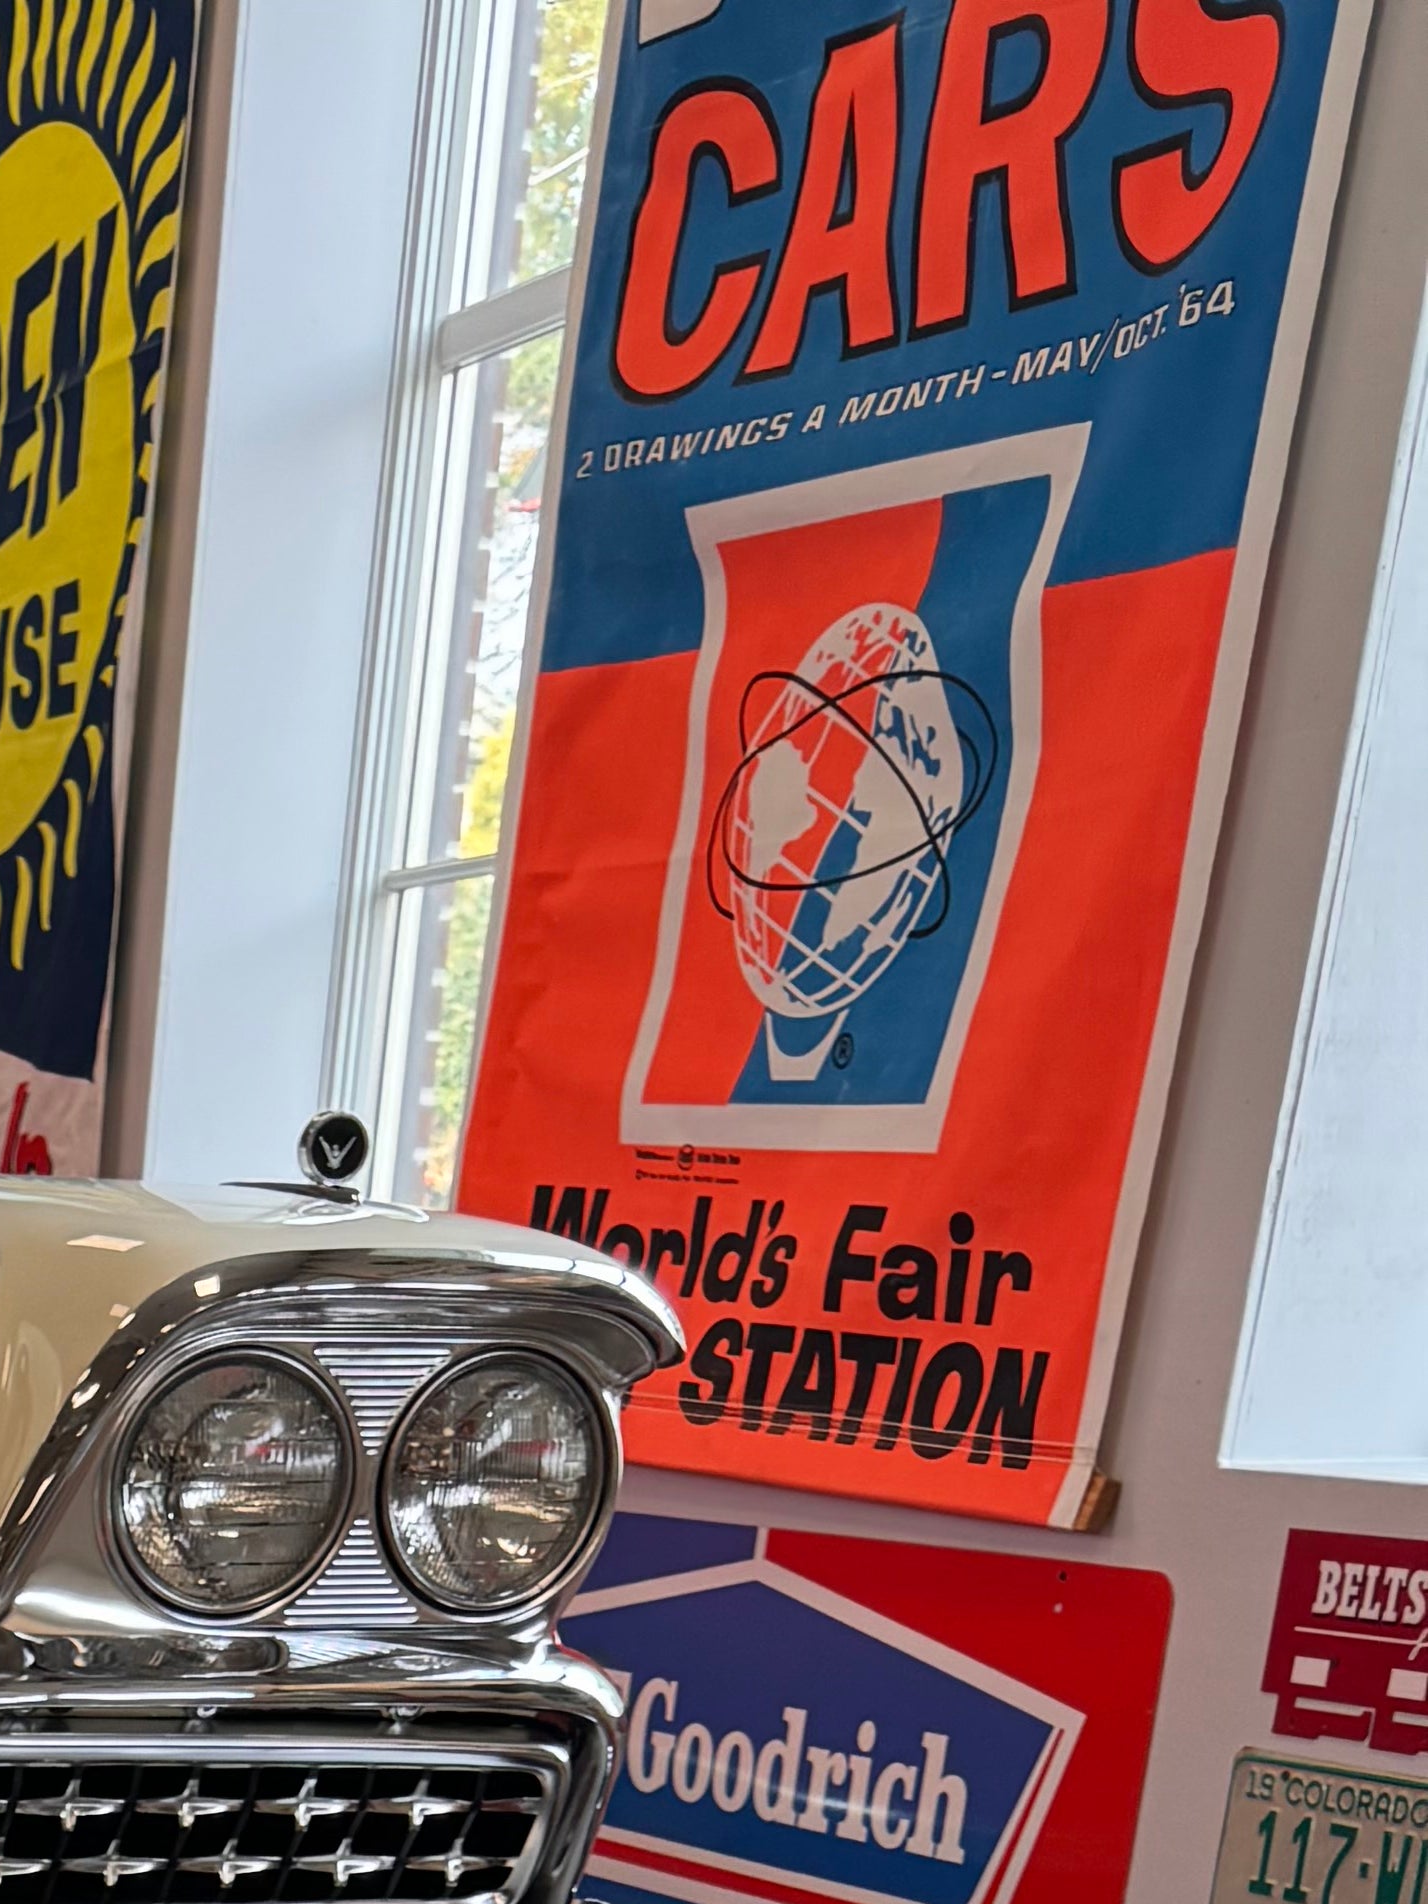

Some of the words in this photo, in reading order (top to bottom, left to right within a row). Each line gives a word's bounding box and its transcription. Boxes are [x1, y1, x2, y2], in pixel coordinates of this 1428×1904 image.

[611, 0, 1284, 403] CARS
[576, 451, 592, 478] 2
[603, 412, 792, 471] DRAWINGS
[801, 404, 824, 434] A
[1176, 281, 1236, 328] '64
[530, 1184, 797, 1309] World's
[823, 1203, 1033, 1326] Fair
[679, 1318, 1050, 1469] STATION
[628, 1677, 967, 1865] Goodrich
[1284, 1775, 1428, 1828] COLORADO
